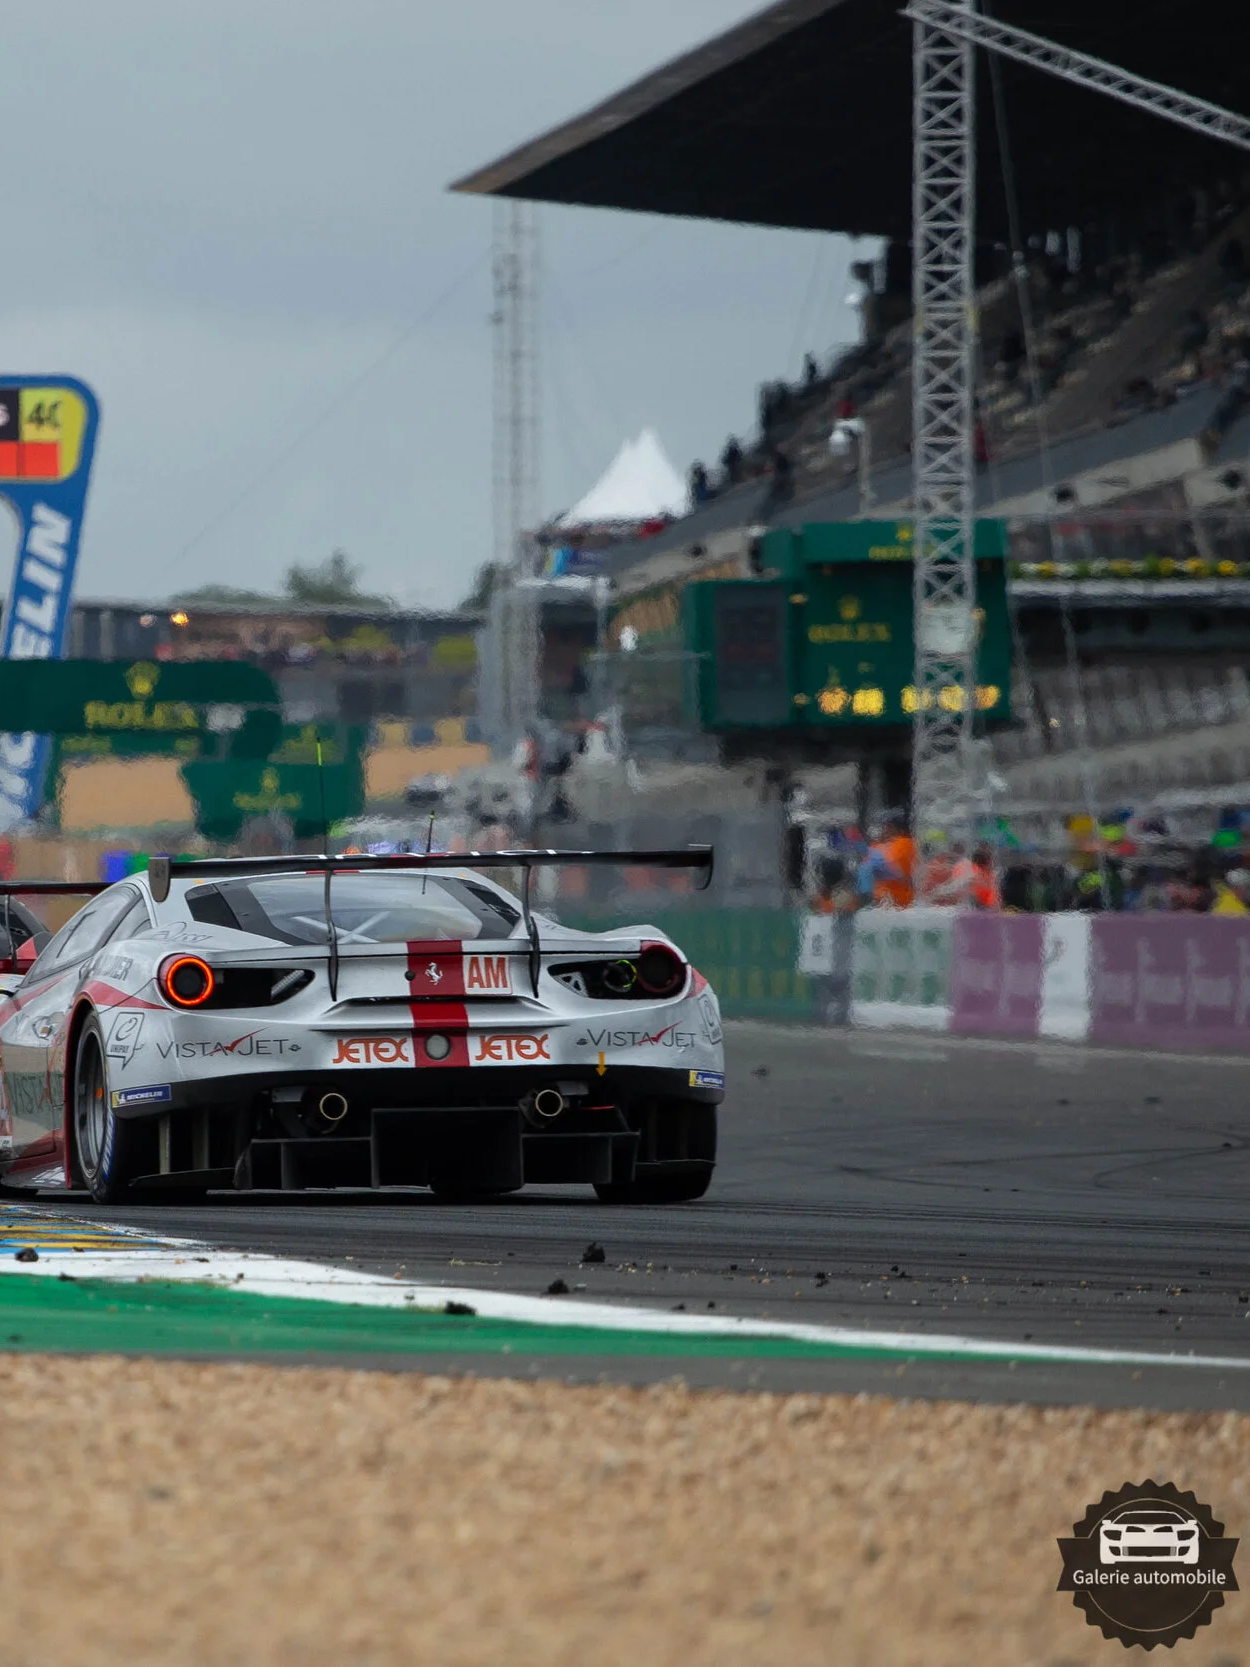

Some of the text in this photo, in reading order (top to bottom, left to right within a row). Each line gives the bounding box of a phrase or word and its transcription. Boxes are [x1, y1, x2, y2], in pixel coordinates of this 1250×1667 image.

[467, 956, 509, 989] AM
[332, 1037, 409, 1064] JETEX
[474, 1034, 551, 1061] JETEX
